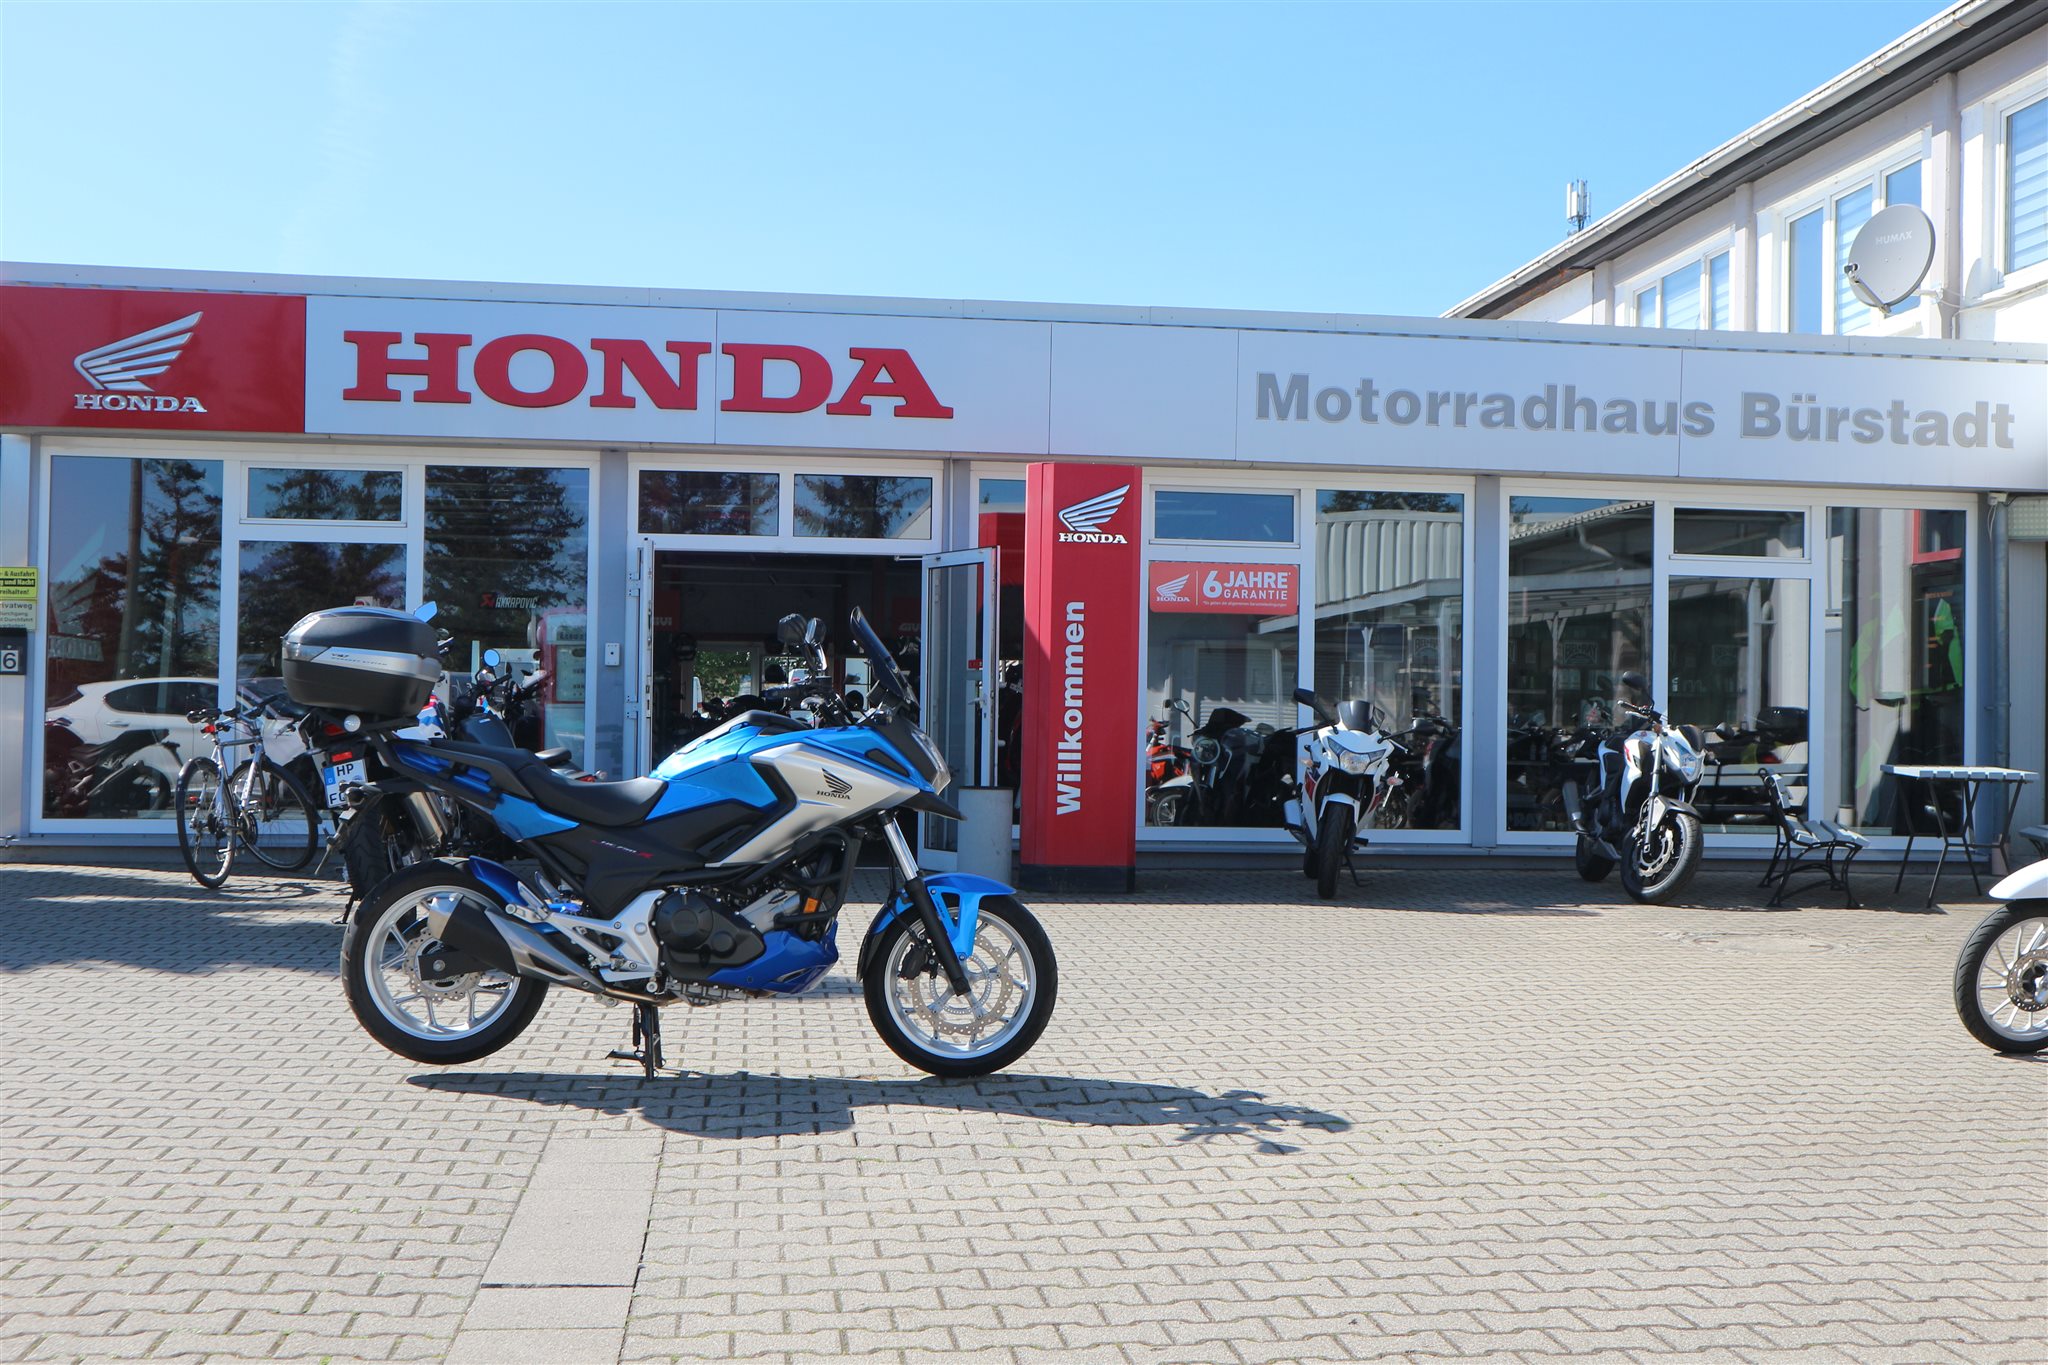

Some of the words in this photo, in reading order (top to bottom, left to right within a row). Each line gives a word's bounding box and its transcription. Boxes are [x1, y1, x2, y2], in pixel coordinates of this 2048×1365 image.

[1876, 231, 1912, 245] HUMAX
[343, 330, 954, 419] HONDA
[74, 393, 208, 414] HONDA
[1256, 372, 1716, 437] Motorradhaus
[1740, 391, 2016, 449] Bürstadt
[1058, 532, 1128, 545] HONDA
[1203, 570, 1222, 598] 6
[1224, 589, 1287, 600] GARANTIE
[3, 652, 17, 670] 6
[1056, 601, 1086, 816] Willkommen
[336, 763, 354, 777] HP
[816, 790, 851, 800] HONDA
